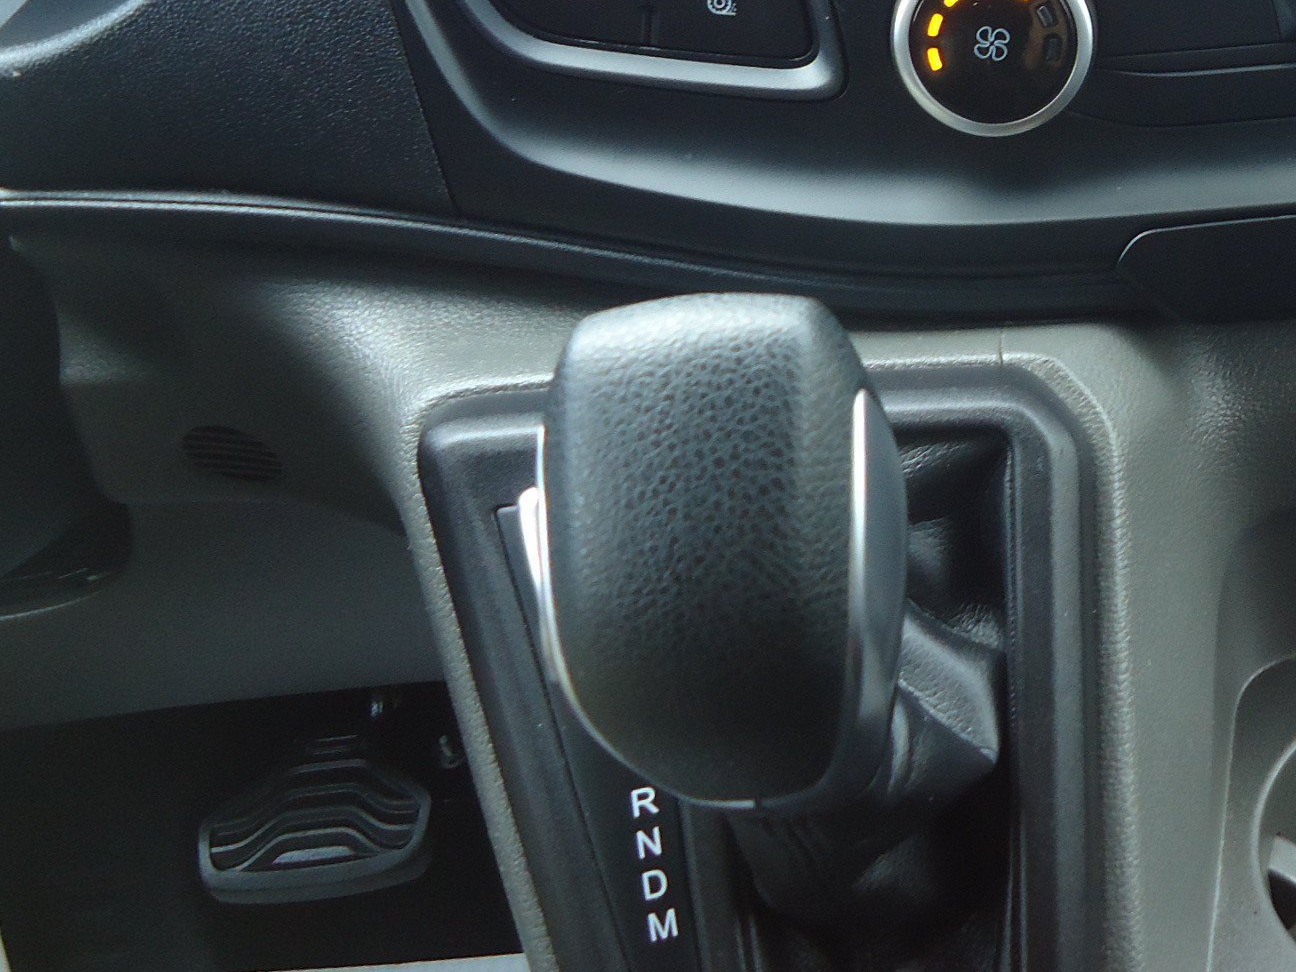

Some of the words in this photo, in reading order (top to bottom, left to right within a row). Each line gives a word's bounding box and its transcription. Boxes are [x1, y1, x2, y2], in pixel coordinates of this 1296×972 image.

[629, 786, 660, 818] R
[635, 826, 663, 860] N
[641, 869, 668, 901] D
[647, 908, 679, 943] M
